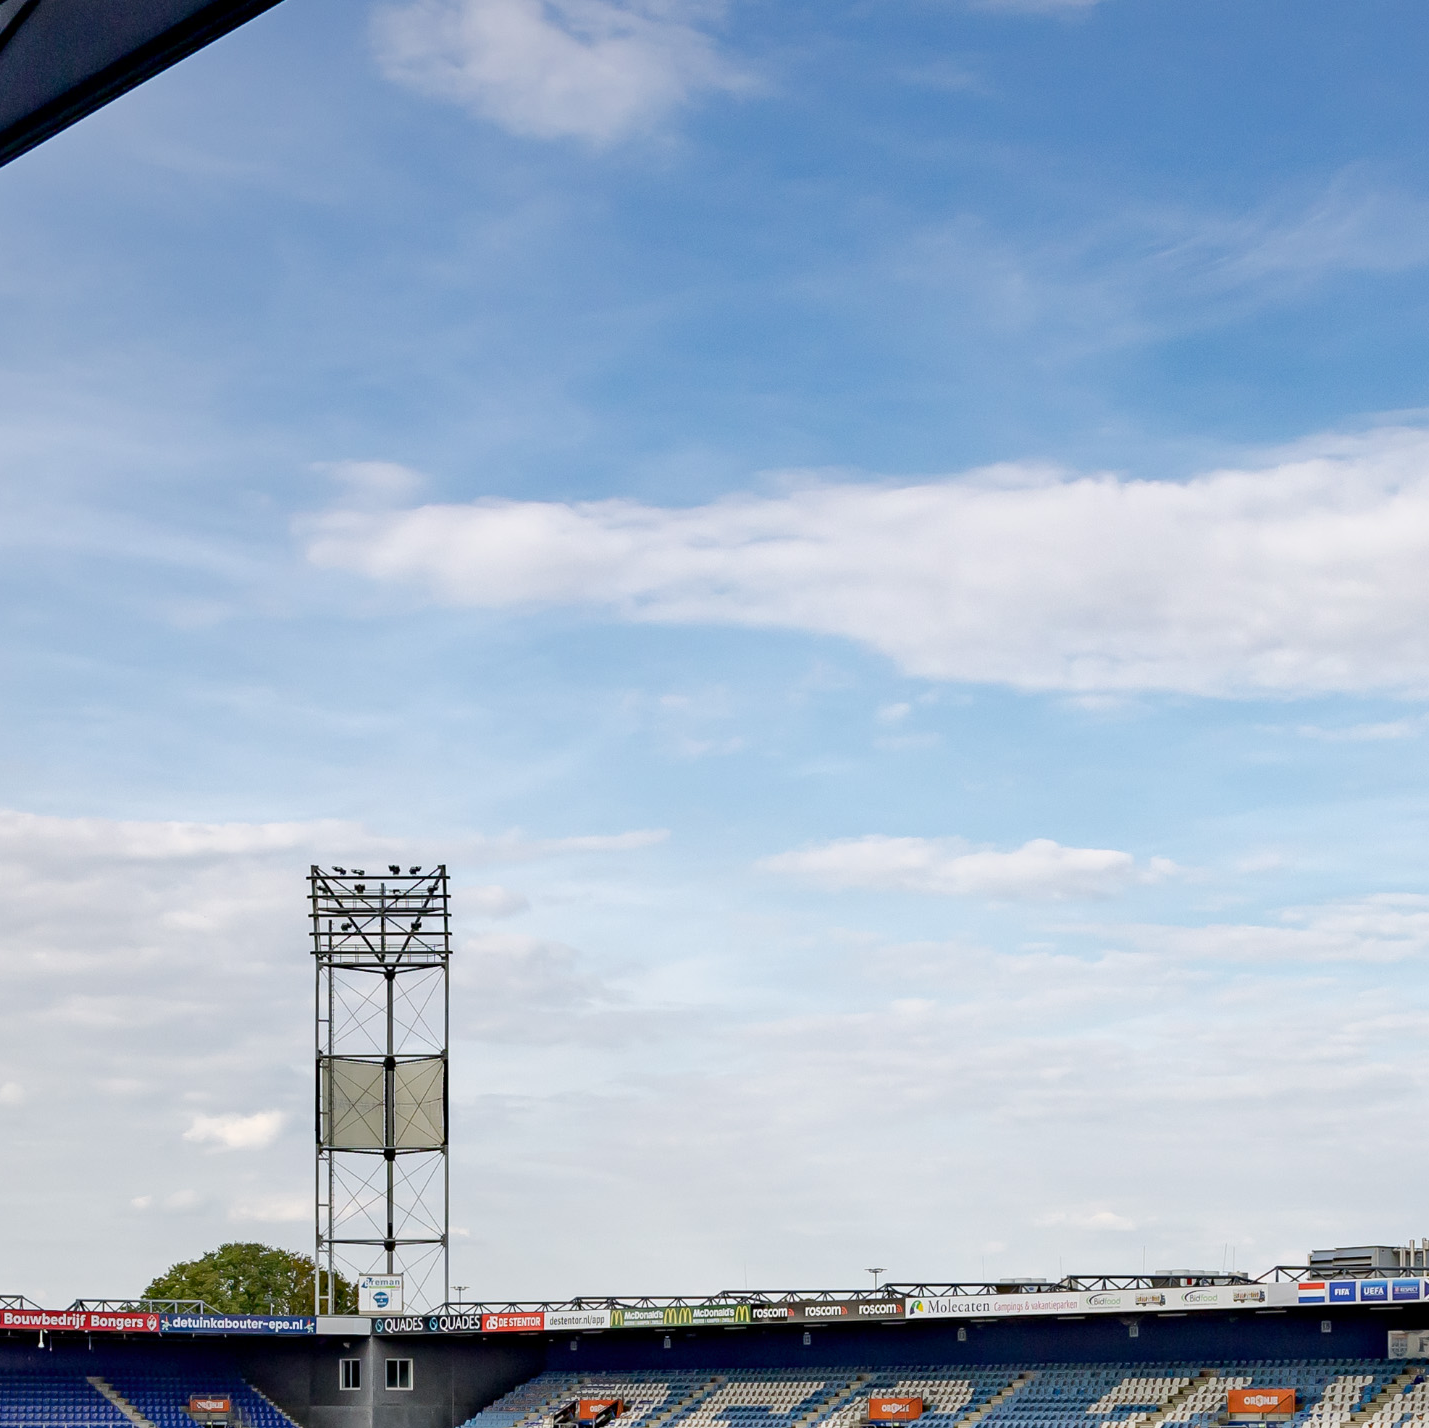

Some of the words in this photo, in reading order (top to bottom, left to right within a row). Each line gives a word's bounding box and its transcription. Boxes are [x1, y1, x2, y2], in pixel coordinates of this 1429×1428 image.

[1334, 1288, 1351, 1296] FIFA
[1363, 1287, 1385, 1295] UEFA
[1093, 1297, 1121, 1306] Bidfood
[1189, 1294, 1218, 1303] Bidfood
[752, 1307, 788, 1318] roscom
[804, 1305, 842, 1317] roscom
[858, 1303, 897, 1315] roscom
[928, 1299, 991, 1314] Molecaten
[994, 1300, 1023, 1313] Campings
[1031, 1299, 1078, 1312] vakantieparken
[624, 1310, 664, 1320] McDonald's
[693, 1308, 735, 1318] McDonald's
[3, 1312, 86, 1328] Bouwbedrijf
[90, 1314, 144, 1329] Bongers
[172, 1317, 303, 1332] detuinkabouter-epe.nl
[384, 1318, 423, 1333] QUADES
[440, 1315, 480, 1331] QUADES
[498, 1317, 509, 1328] DE
[509, 1316, 541, 1328] STENTOR
[549, 1314, 605, 1328] destentor.nl/app
[881, 1403, 910, 1414] ORNJE
